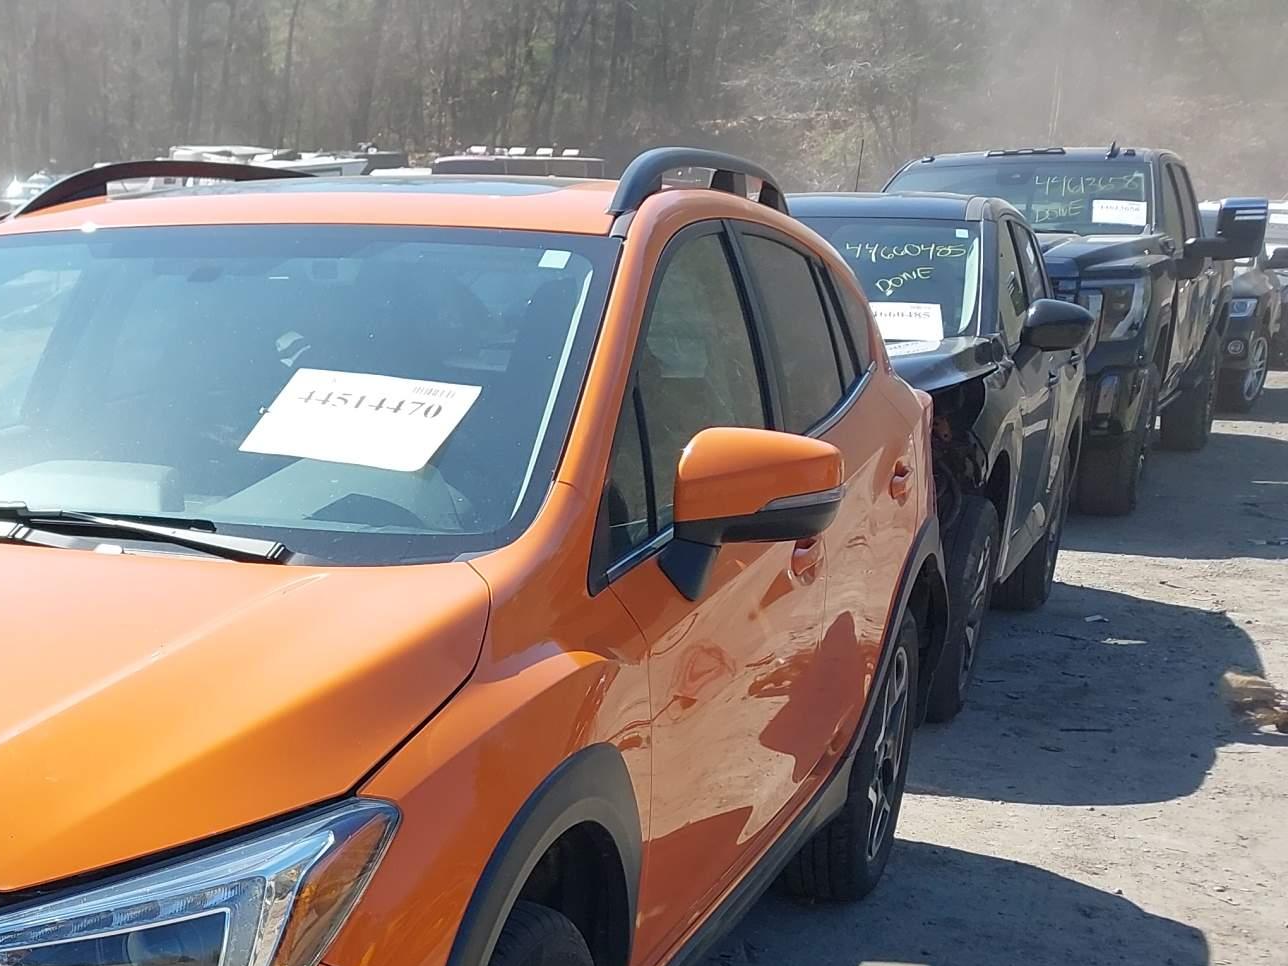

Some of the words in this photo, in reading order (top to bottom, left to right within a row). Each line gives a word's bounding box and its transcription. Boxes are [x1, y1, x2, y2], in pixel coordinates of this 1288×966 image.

[846, 243, 967, 262] 44660485
[875, 267, 935, 297] DONE
[299, 390, 443, 418] 44514470
